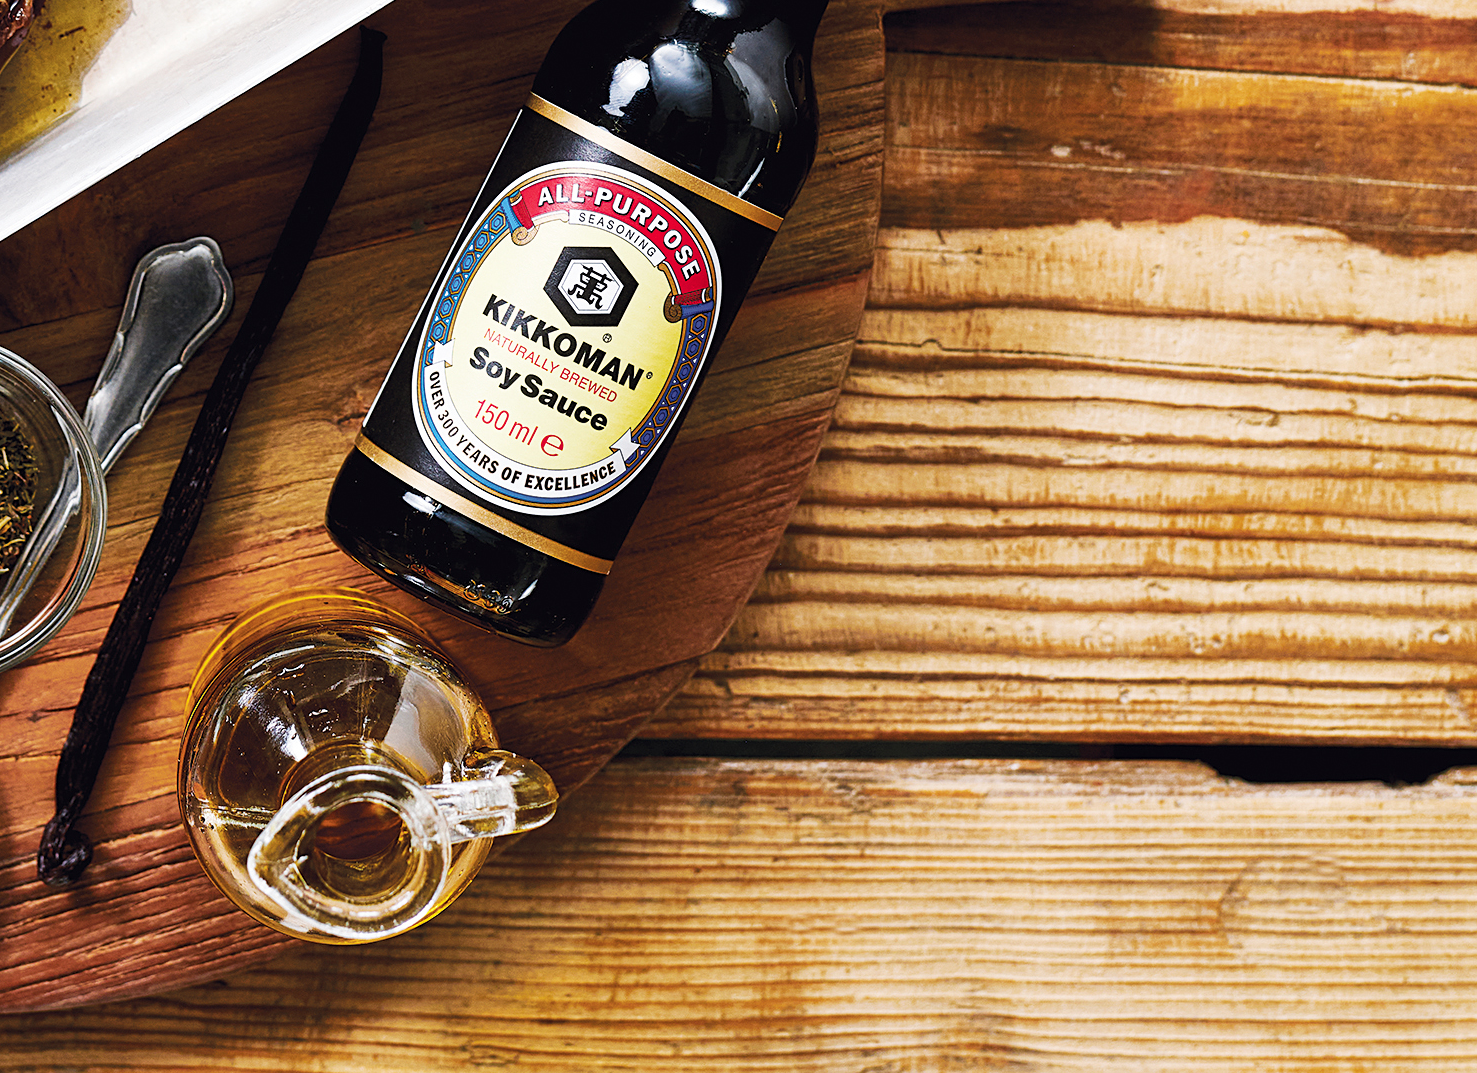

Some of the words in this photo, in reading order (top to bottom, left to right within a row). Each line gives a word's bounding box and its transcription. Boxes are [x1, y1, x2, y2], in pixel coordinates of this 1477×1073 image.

[537, 183, 701, 280] ALL-PURPOSE
[578, 212, 656, 257] SEASONING
[482, 294, 644, 391] KIKKOMAN
[469, 346, 520, 389] Soy
[520, 373, 608, 430] Sauce
[484, 328, 559, 374] NATURALLY
[560, 368, 617, 403] BREWED
[430, 370, 446, 409] OVER
[437, 409, 458, 438] 300
[475, 399, 509, 430] 150
[509, 418, 538, 446] ml
[455, 435, 500, 474] YEARS
[501, 468, 521, 484] OF
[525, 461, 616, 491] EXCELLENCE
